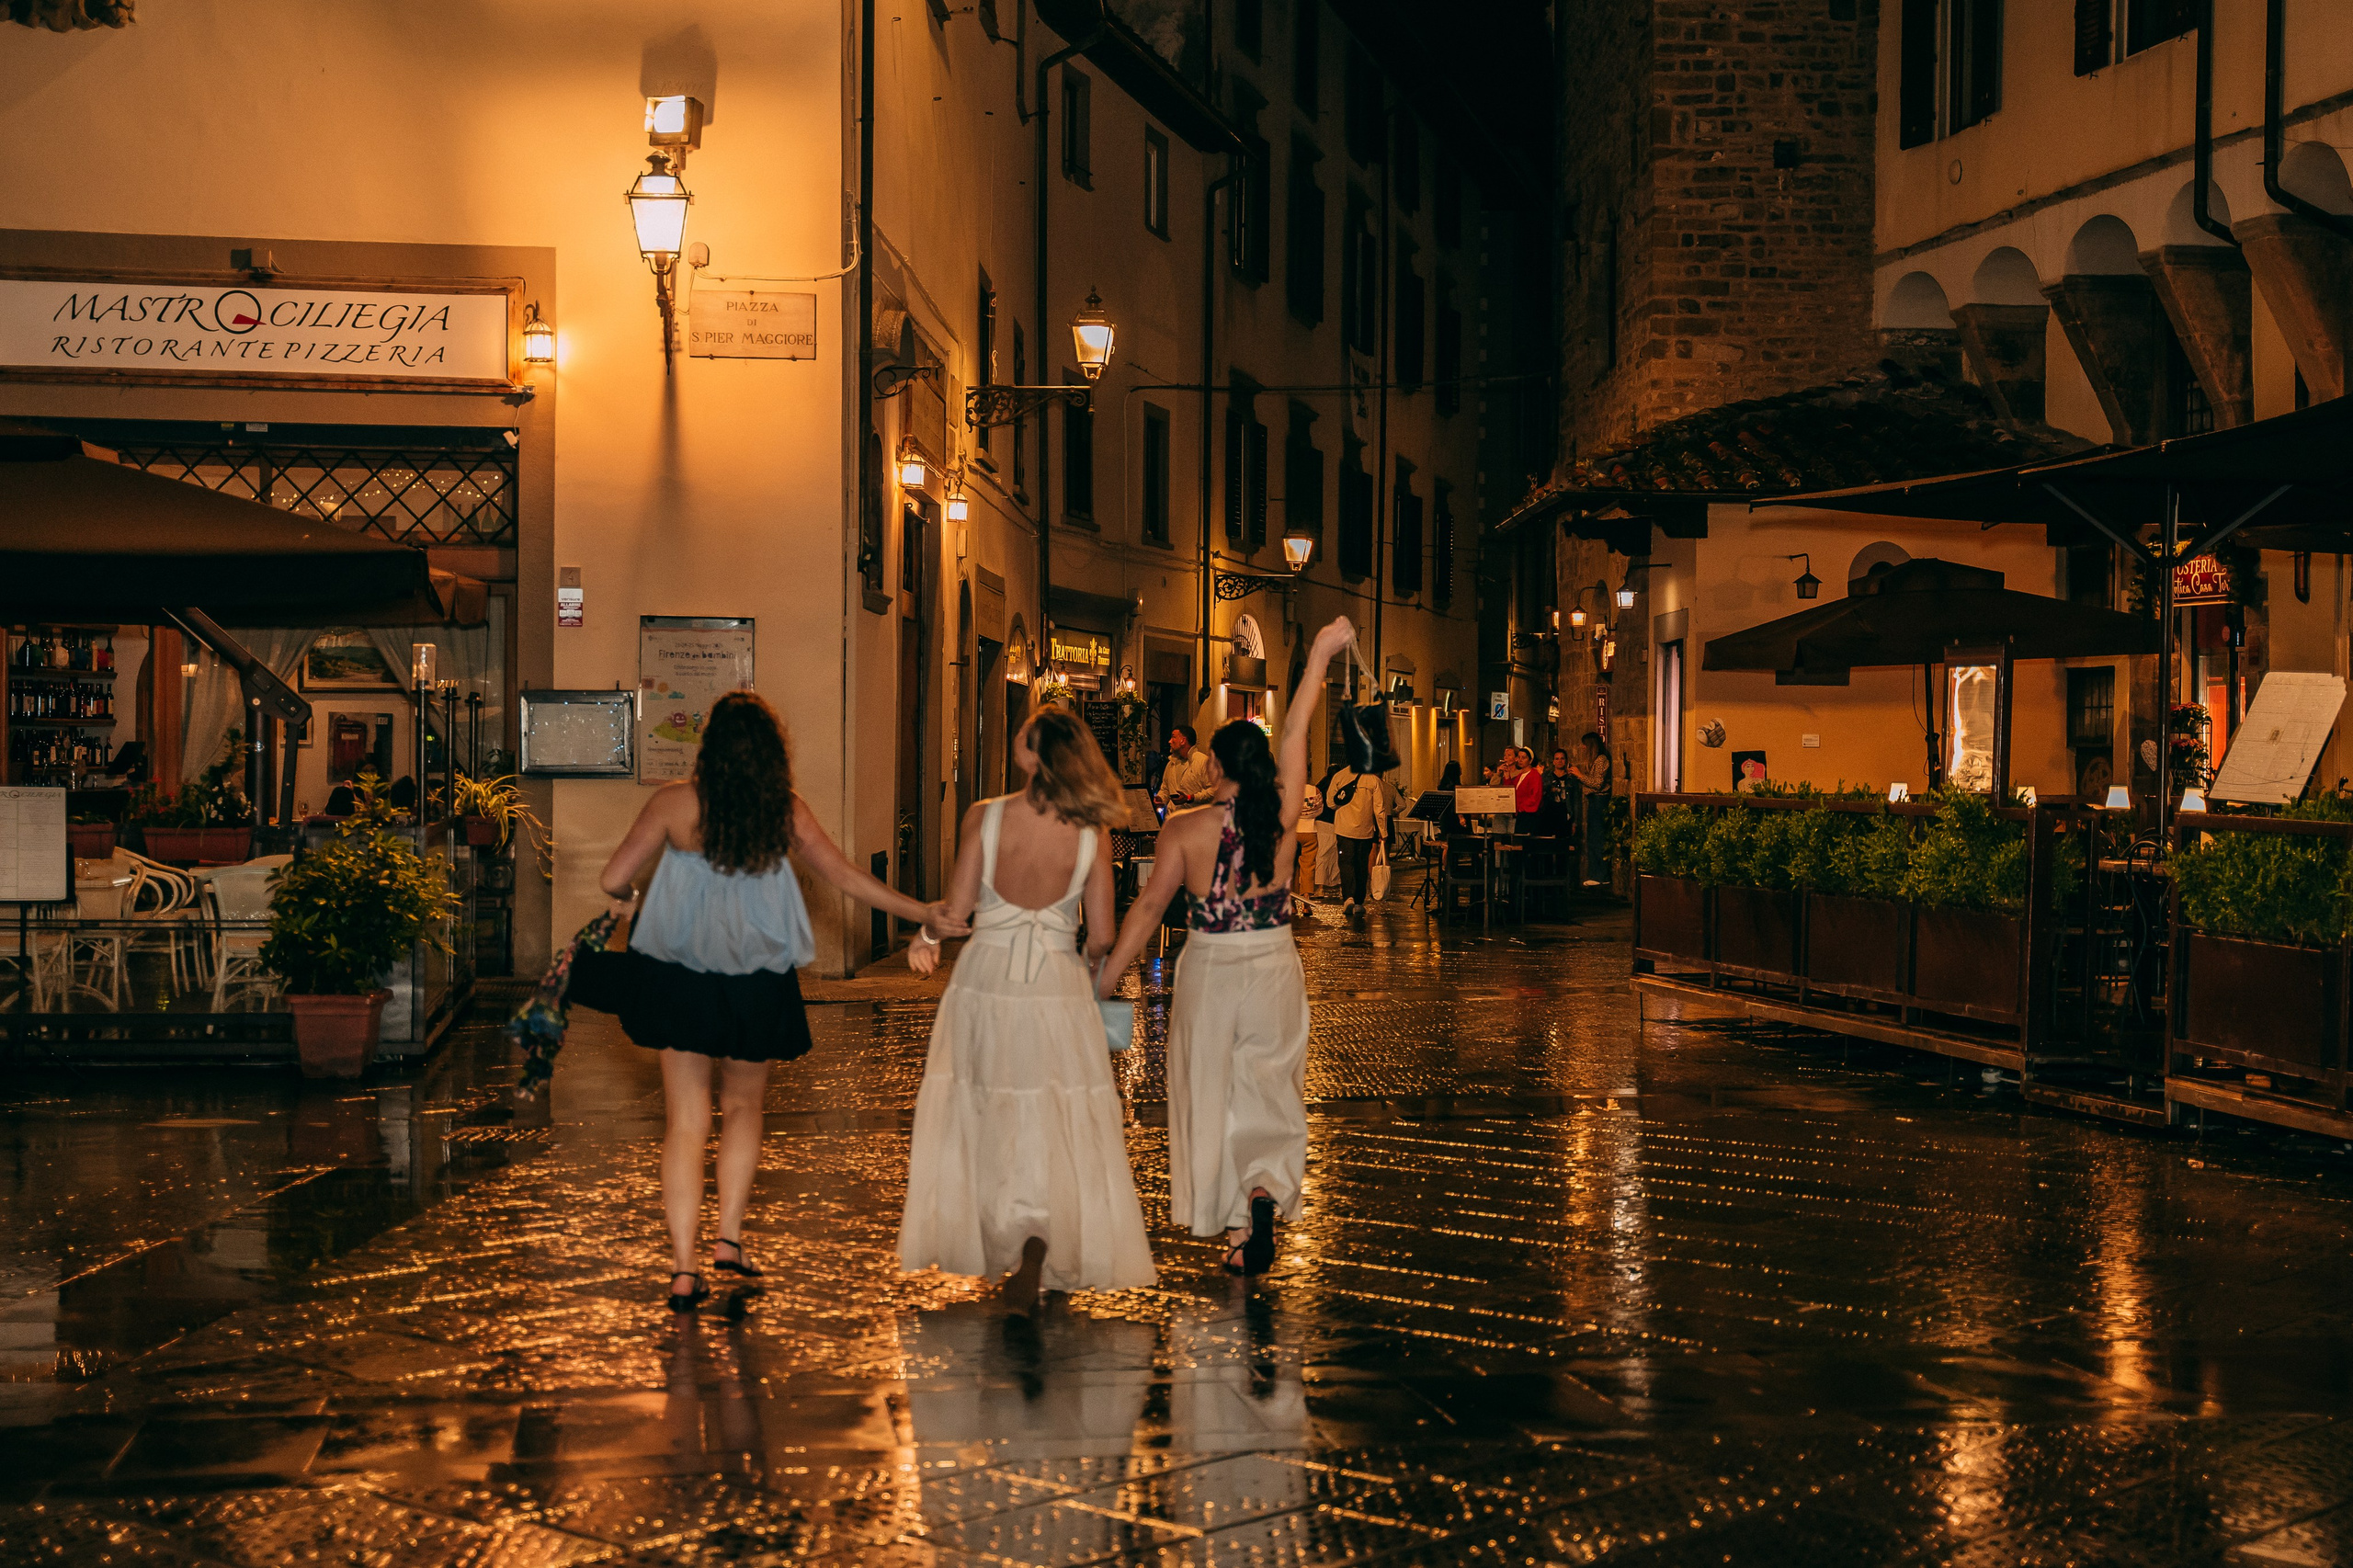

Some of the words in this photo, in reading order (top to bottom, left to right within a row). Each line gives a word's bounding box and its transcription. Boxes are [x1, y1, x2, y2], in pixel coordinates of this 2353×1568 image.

[726, 301, 779, 312] PIAZZA
[746, 318, 757, 326] DI
[705, 332, 733, 344] PIER
[742, 333, 813, 346] MAGGIORE
[51, 335, 275, 362] RISTORANTE
[284, 342, 445, 367] PIZZERIA
[2191, 573, 2213, 596] Casa
[658, 649, 690, 659] Firenze
[1051, 637, 1089, 664] TRATTORIA
